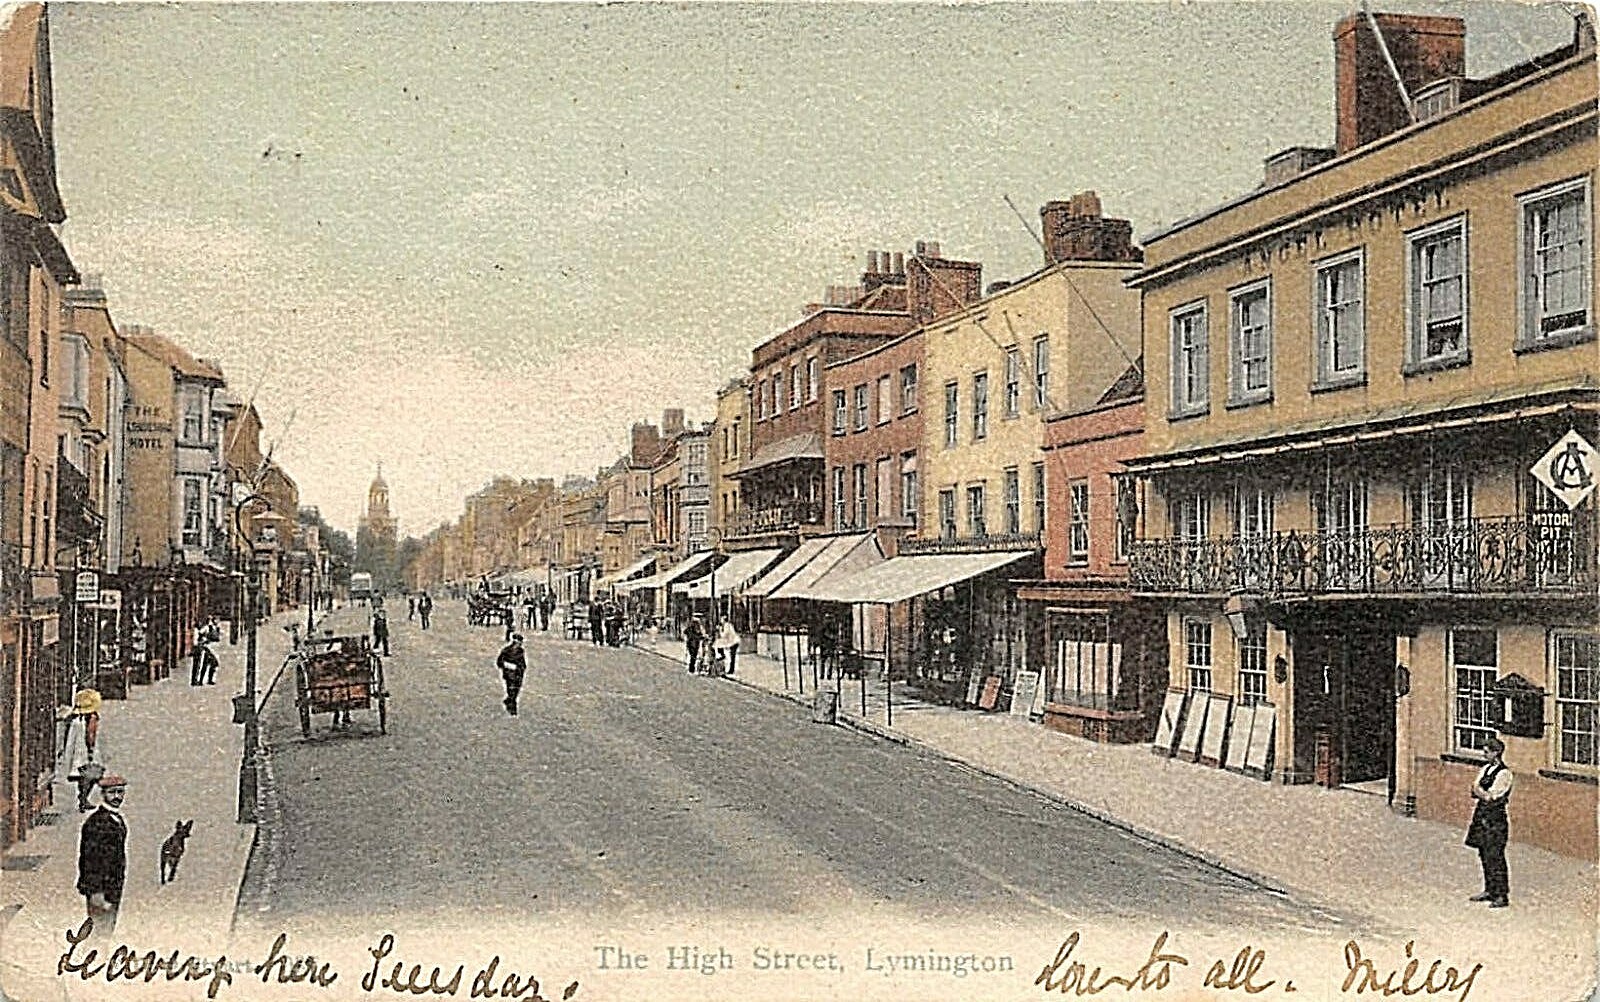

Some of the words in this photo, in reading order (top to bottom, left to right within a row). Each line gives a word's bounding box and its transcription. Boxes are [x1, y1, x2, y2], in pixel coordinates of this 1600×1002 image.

[134, 406, 160, 417] THE
[129, 437, 164, 449] HOTEL
[1532, 513, 1571, 527] MOTOR
[1540, 527, 1561, 540] PIT
[254, 932, 338, 987] here
